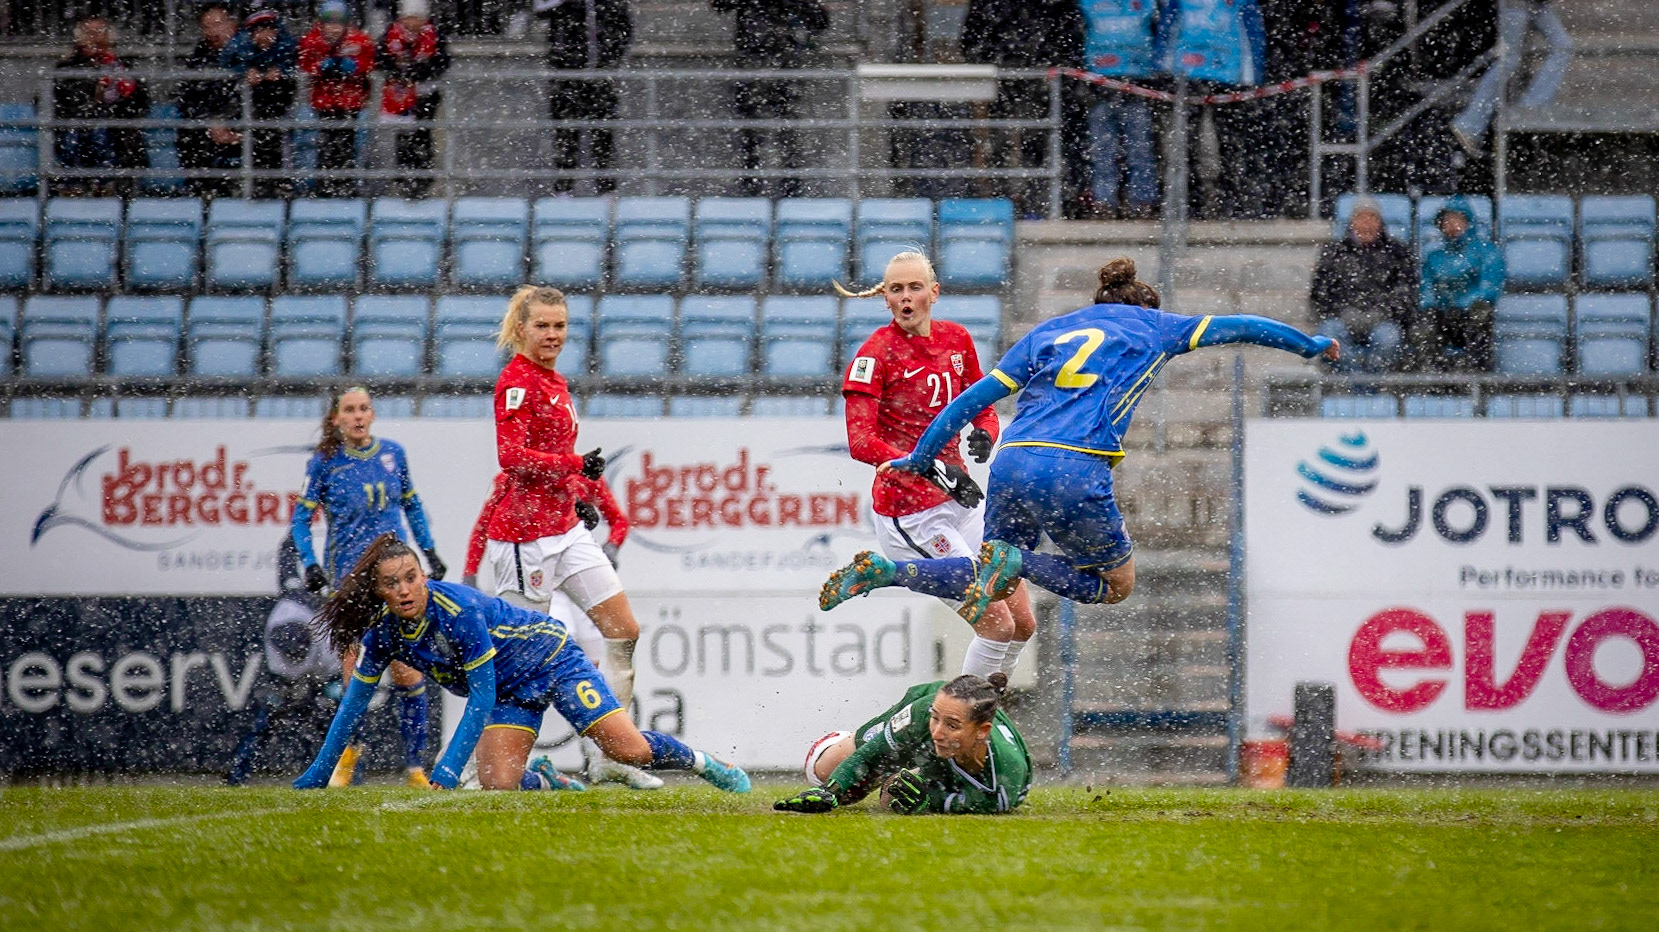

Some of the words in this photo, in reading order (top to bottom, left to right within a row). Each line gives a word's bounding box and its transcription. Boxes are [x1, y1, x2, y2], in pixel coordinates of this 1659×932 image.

[1054, 328, 1105, 389] 2
[926, 371, 954, 408] 21
[103, 488, 323, 526] BERGGR
[363, 481, 387, 509] 11
[626, 490, 862, 528] BERGGREN
[1372, 485, 1659, 544] JOTRO
[1461, 567, 1625, 589] Performance
[639, 605, 910, 677] ömstad
[1348, 606, 1659, 714] evo
[576, 681, 602, 709] 6
[1356, 728, 1659, 760] TRENINGSSENTE
